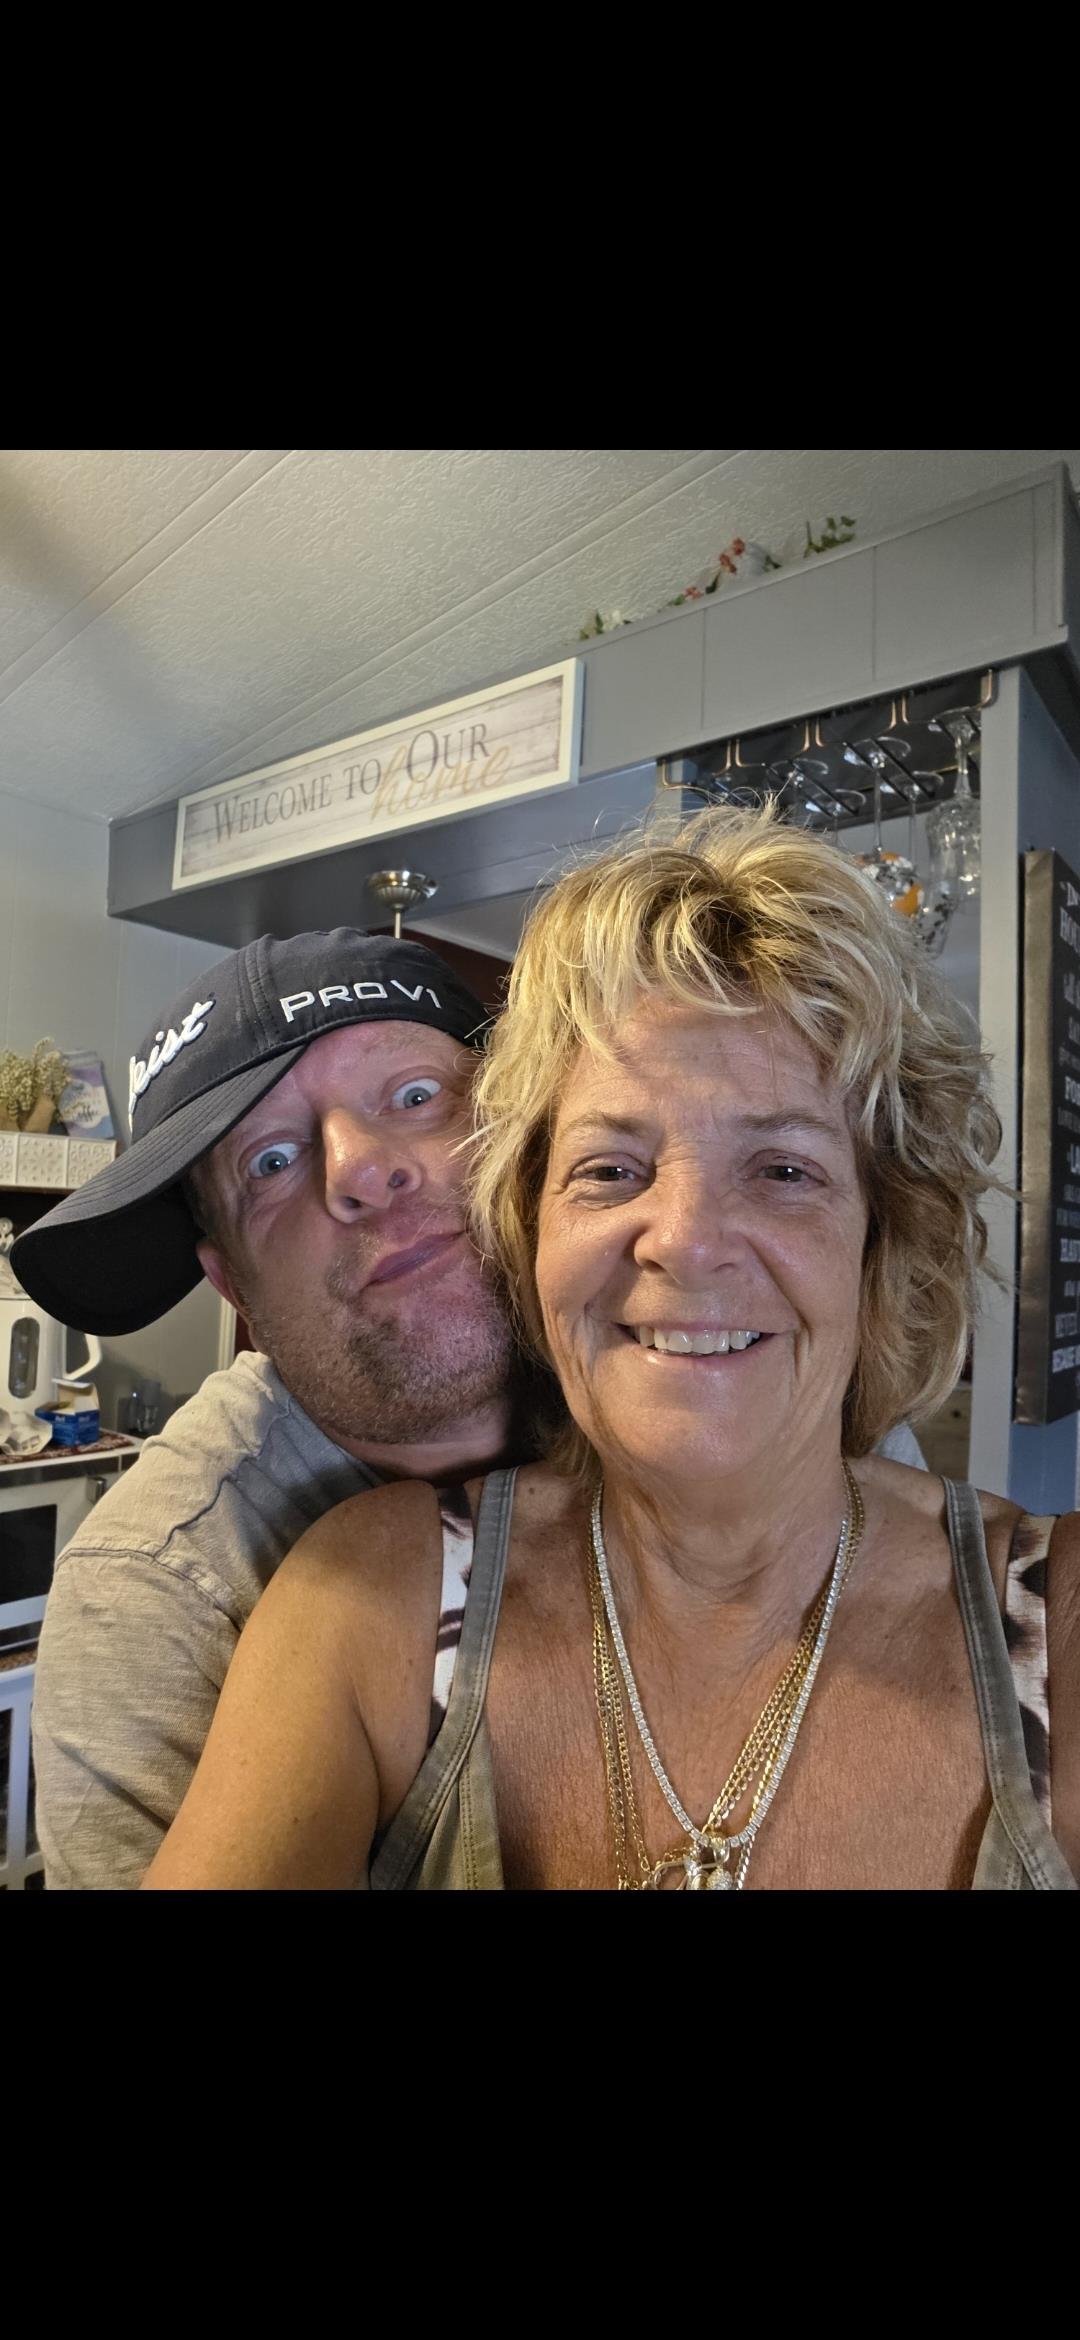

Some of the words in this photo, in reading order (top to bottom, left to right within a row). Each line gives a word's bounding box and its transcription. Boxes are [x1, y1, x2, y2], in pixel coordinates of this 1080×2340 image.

[213, 773, 333, 844] WELCOME
[343, 758, 382, 801] TO
[407, 723, 491, 784] OUR
[370, 744, 513, 824] home
